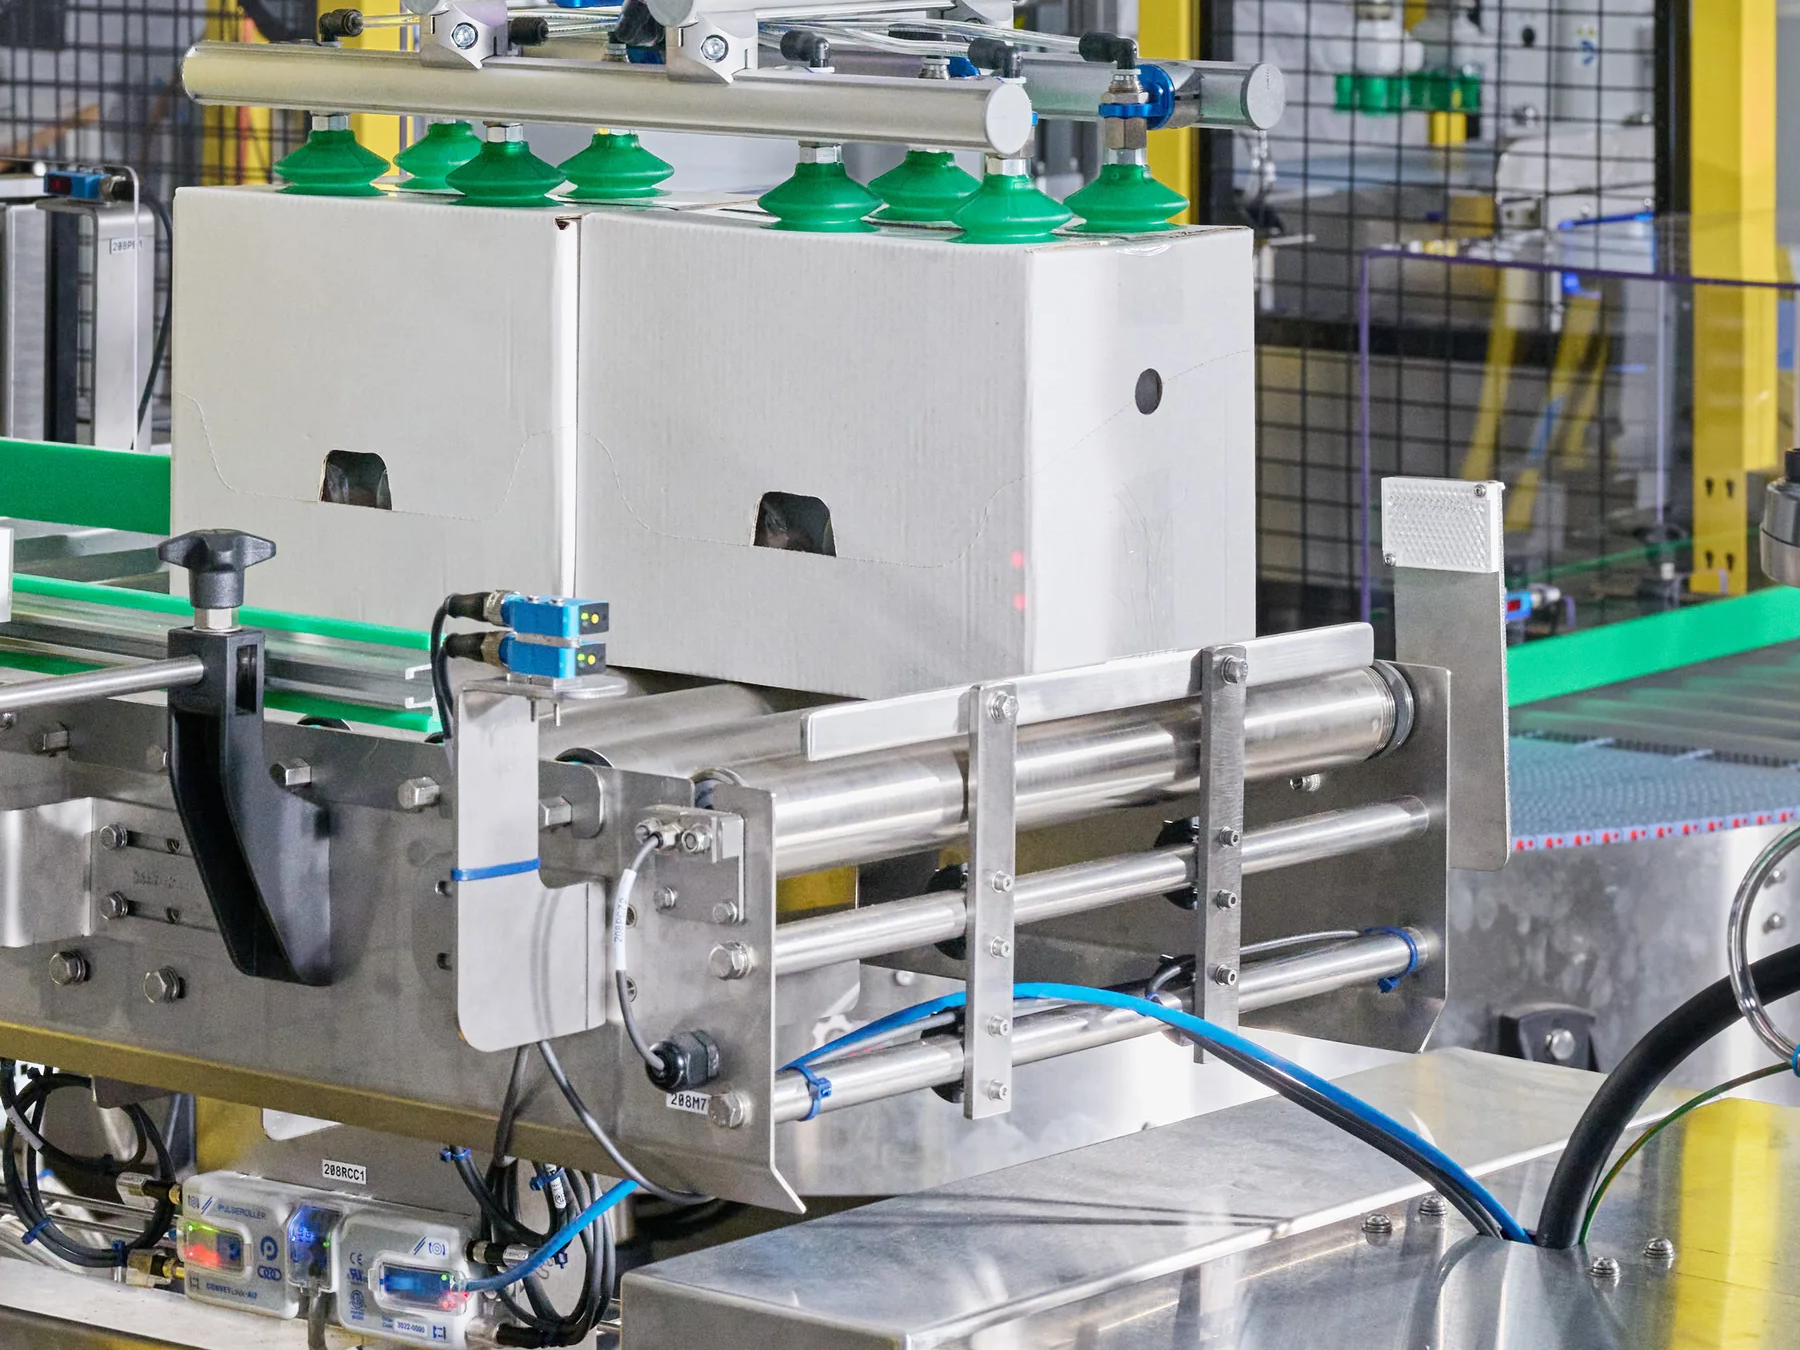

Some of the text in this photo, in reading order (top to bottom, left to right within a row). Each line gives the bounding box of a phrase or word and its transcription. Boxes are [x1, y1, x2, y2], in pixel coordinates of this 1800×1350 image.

[671, 1092, 707, 1110] 208M7
[324, 1163, 365, 1182] 208RCC1
[217, 1203, 267, 1220] PULSEROLLER
